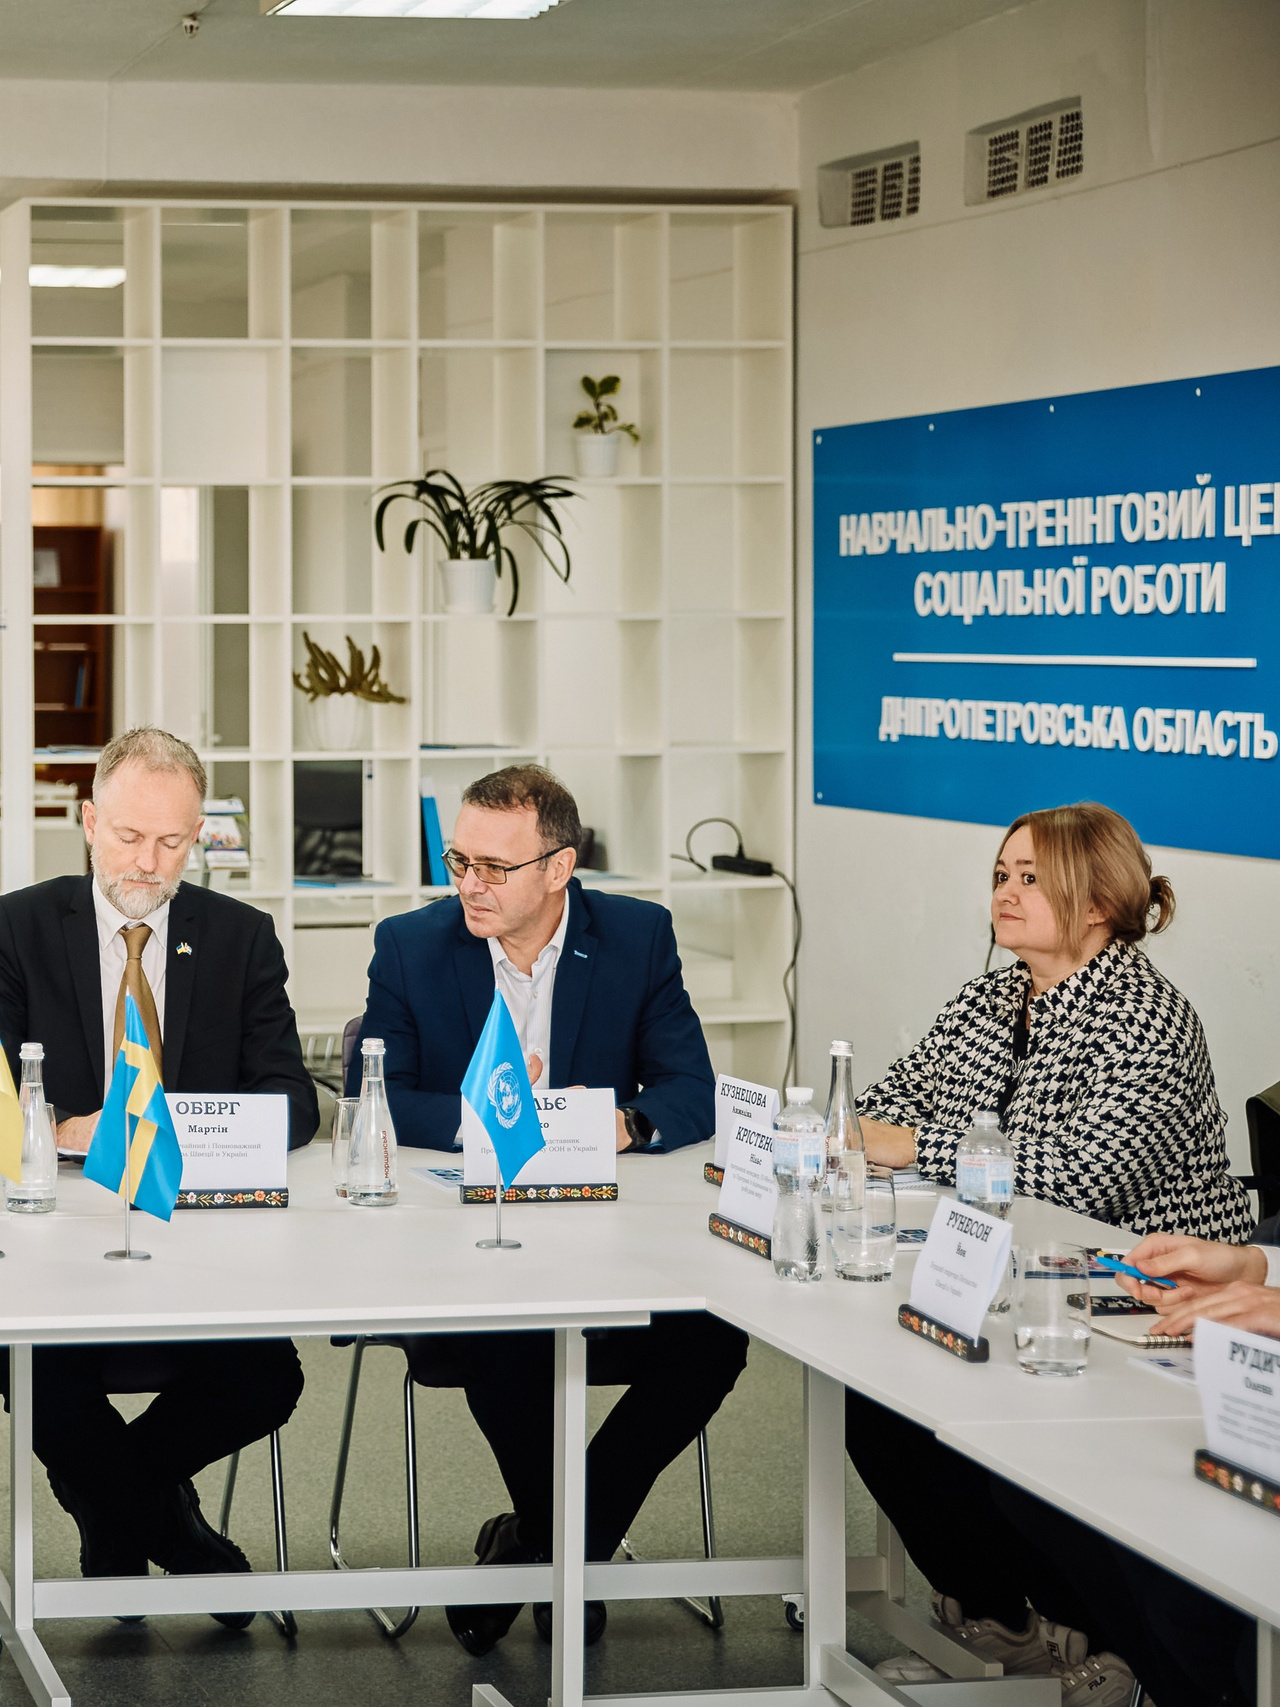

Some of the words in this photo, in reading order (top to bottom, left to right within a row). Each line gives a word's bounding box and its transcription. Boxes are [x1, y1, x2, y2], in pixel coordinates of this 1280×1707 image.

[839, 473, 1216, 556] НАВЧАЛЬНО-ТРЕНІНГОВИЙ
[914, 556, 1088, 624] СОЦІАЛЬНОЇ
[1091, 562, 1226, 616] РОБОТИ
[879, 696, 1129, 750] ДНІПРОПЕТРОВСЬКА
[1133, 706, 1279, 760] ОБЛАСТЬ
[175, 1101, 241, 1115] ОБЕРГ
[534, 1097, 567, 1111] ЛЬЄ
[720, 1083, 767, 1108] КУЗНЕЦОВА
[188, 1124, 228, 1135] Мартін
[946, 1210, 993, 1243] РУНЕСОН
[1087, 1675, 1107, 1691] FILA
